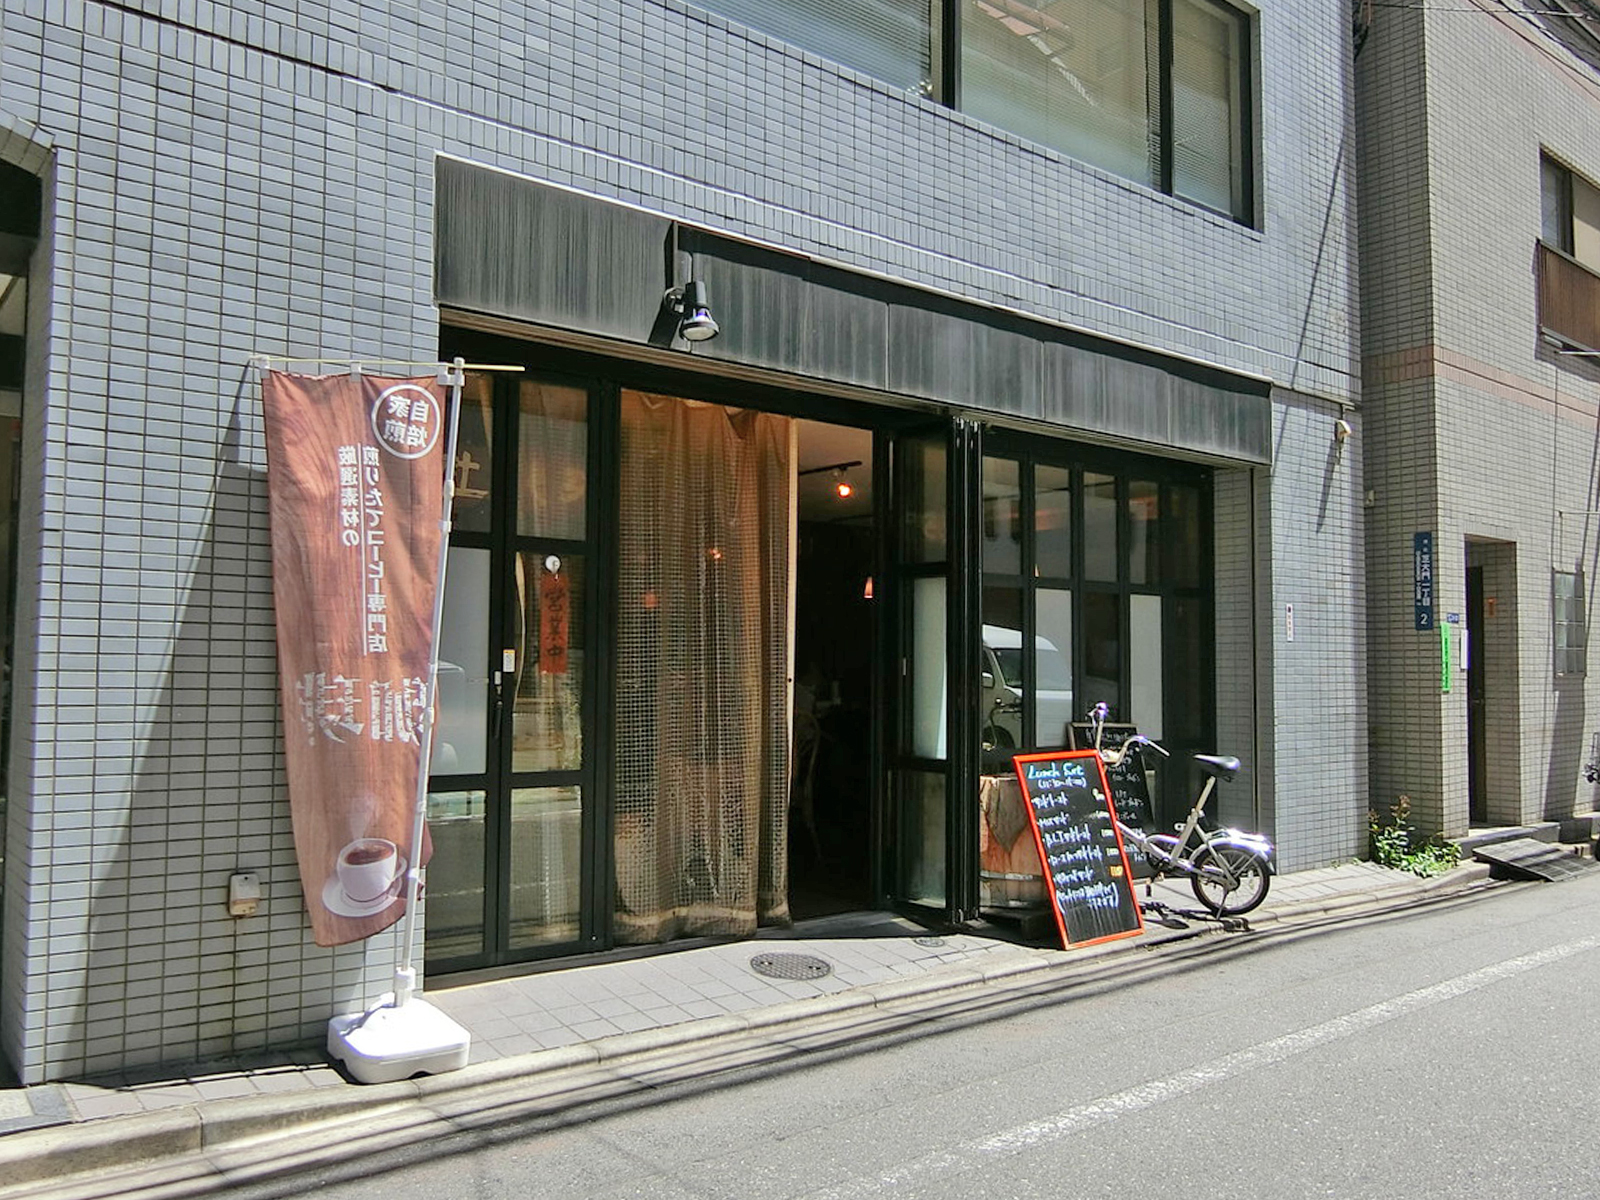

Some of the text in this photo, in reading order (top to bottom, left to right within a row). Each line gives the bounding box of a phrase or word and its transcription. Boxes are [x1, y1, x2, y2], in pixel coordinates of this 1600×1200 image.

[1420, 613, 1428, 625] 2
[1028, 762, 1085, 779] Lunch Set
